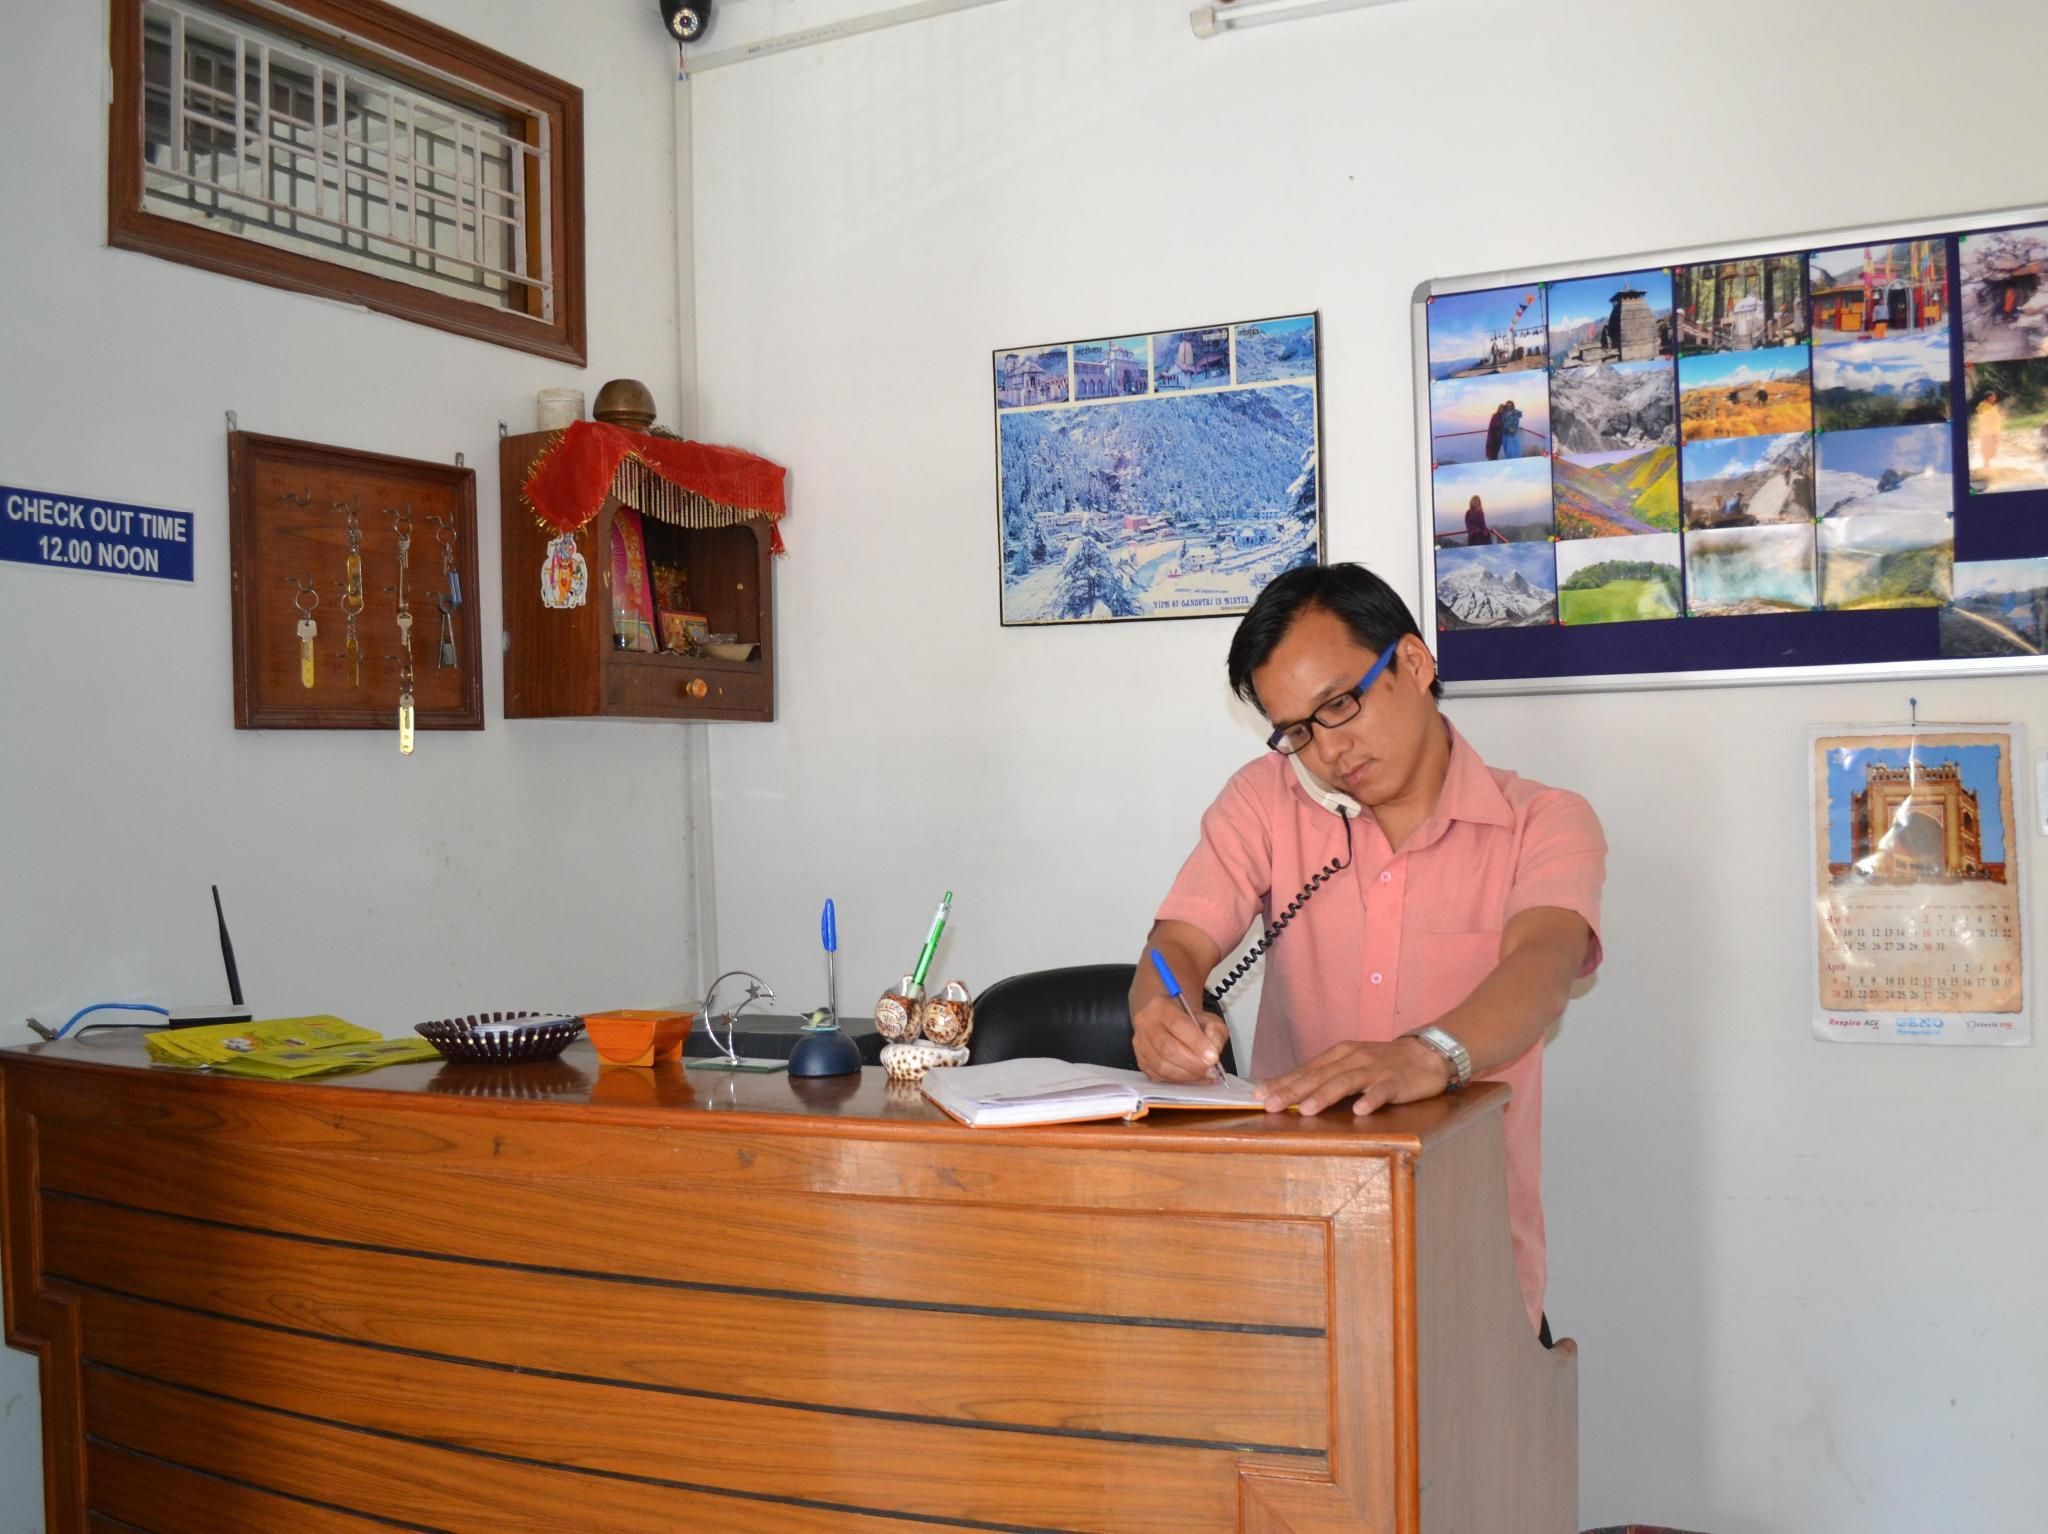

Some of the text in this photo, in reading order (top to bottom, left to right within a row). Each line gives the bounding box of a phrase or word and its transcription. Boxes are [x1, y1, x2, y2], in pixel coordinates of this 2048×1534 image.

[7, 495, 187, 542] CHECK OUT TIME
[39, 536, 159, 573] 12.00 NOON
[1844, 928, 1852, 937] 10
[1857, 928, 1864, 937] 11
[1872, 928, 1880, 937] 12
[1885, 928, 1893, 937] 13
[1923, 928, 1931, 937] 16
[1872, 942, 1881, 951] 26
[1885, 942, 1893, 951] 27
[1936, 942, 1944, 951] 31
[1886, 976, 1894, 986] 10
[1898, 976, 1905, 986] 11
[1845, 990, 1853, 1000] 21
